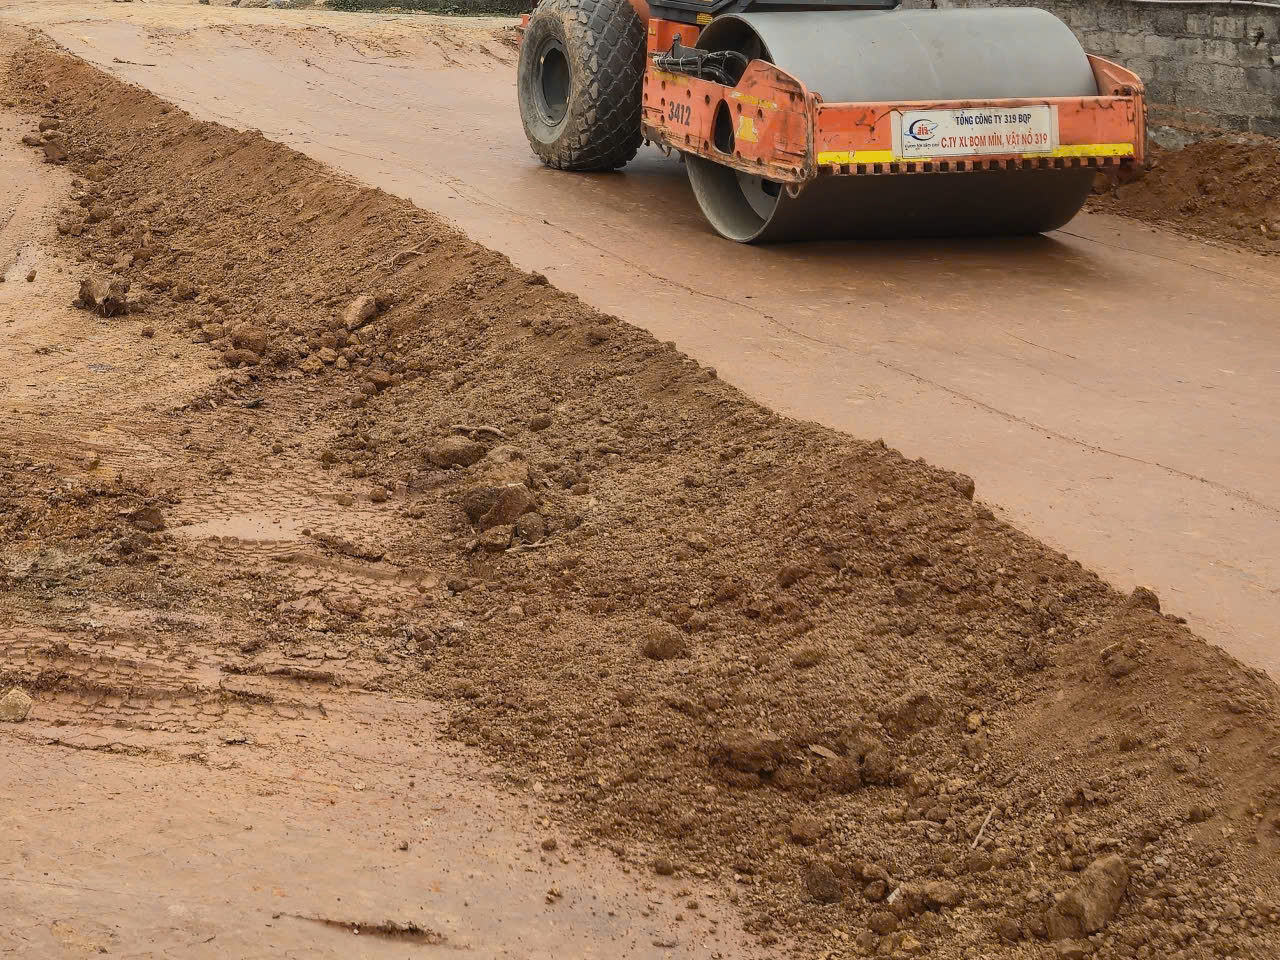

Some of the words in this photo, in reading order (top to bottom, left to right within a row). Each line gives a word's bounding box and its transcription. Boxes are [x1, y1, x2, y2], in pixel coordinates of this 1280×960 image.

[668, 100, 692, 127] 3412
[955, 111, 973, 126] TỔNG
[974, 114, 993, 125] CÔNG
[994, 114, 1003, 124] TY
[1004, 114, 1017, 123] 319
[1018, 113, 1032, 123] BQP
[940, 137, 957, 149] C.TY
[969, 135, 988, 147] BOM
[1034, 133, 1048, 145] 319
